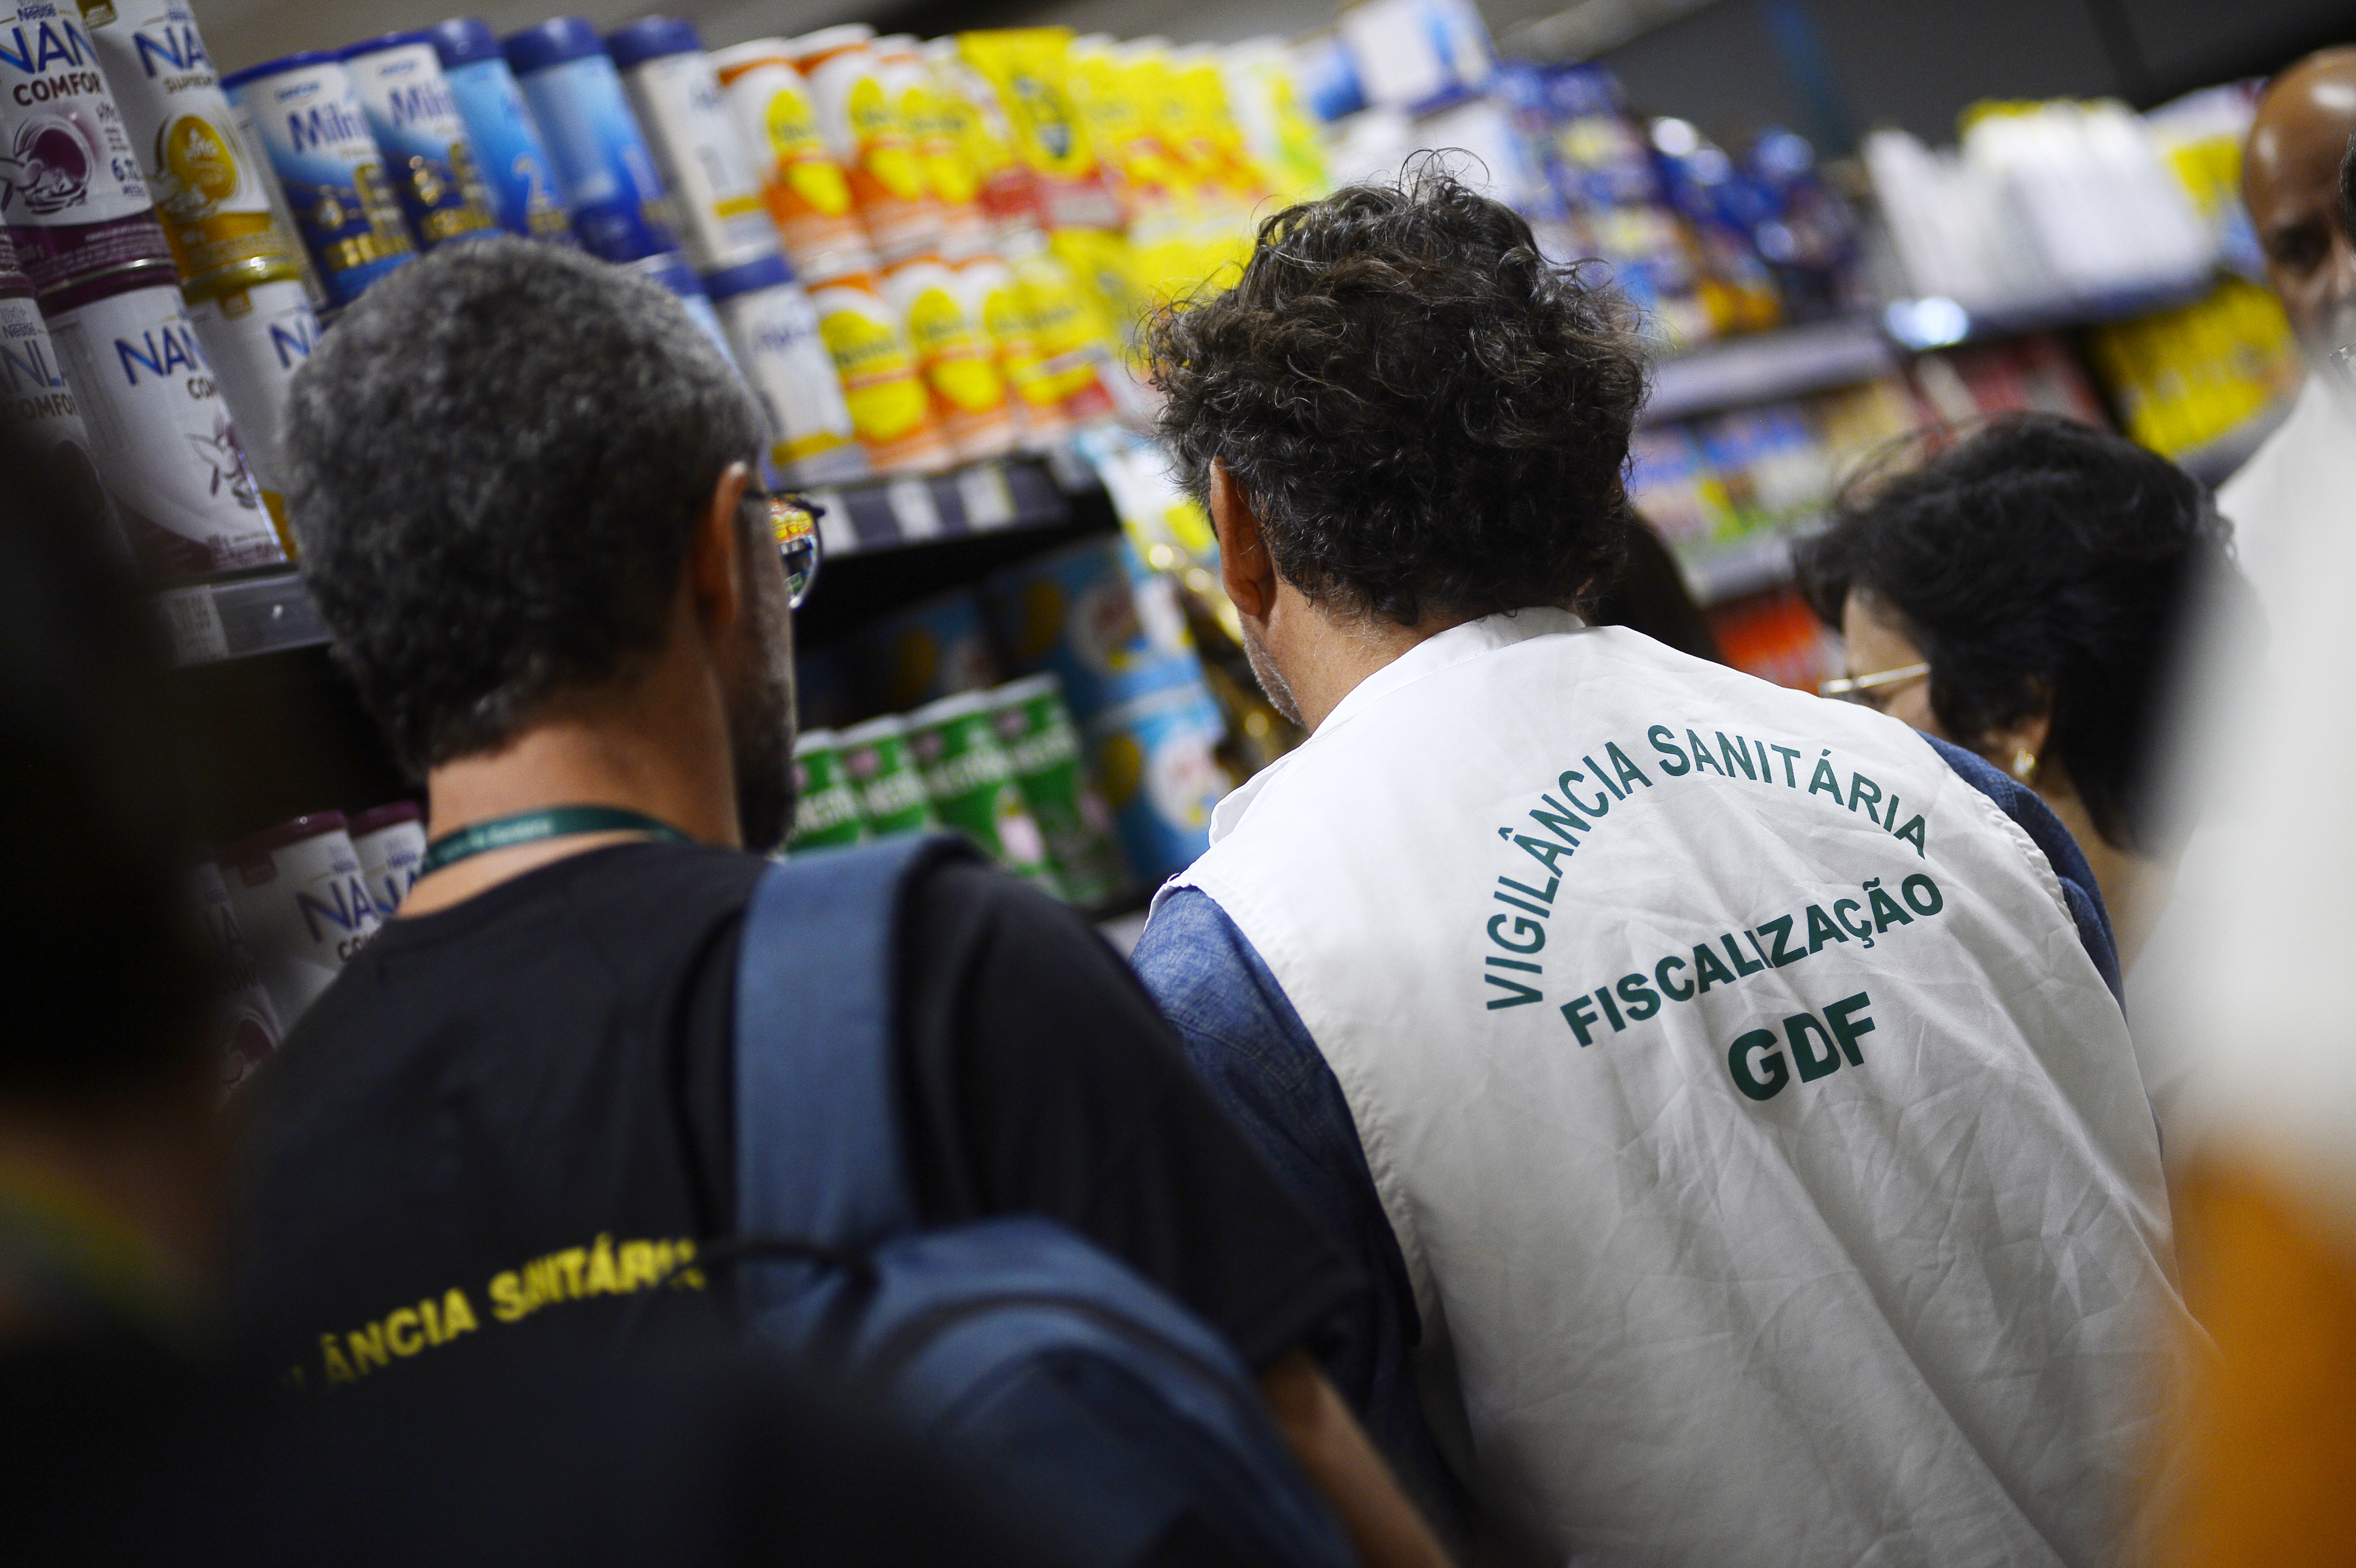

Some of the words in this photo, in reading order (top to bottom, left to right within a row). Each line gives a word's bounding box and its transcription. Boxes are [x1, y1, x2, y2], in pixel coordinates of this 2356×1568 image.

[1484, 741, 1653, 1010] VIGILÂNCIA
[1647, 724, 1926, 860] SANITÁRIA
[1560, 873, 1944, 1047] FISCALIZAÇÃO
[1727, 991, 1876, 1100] GDF
